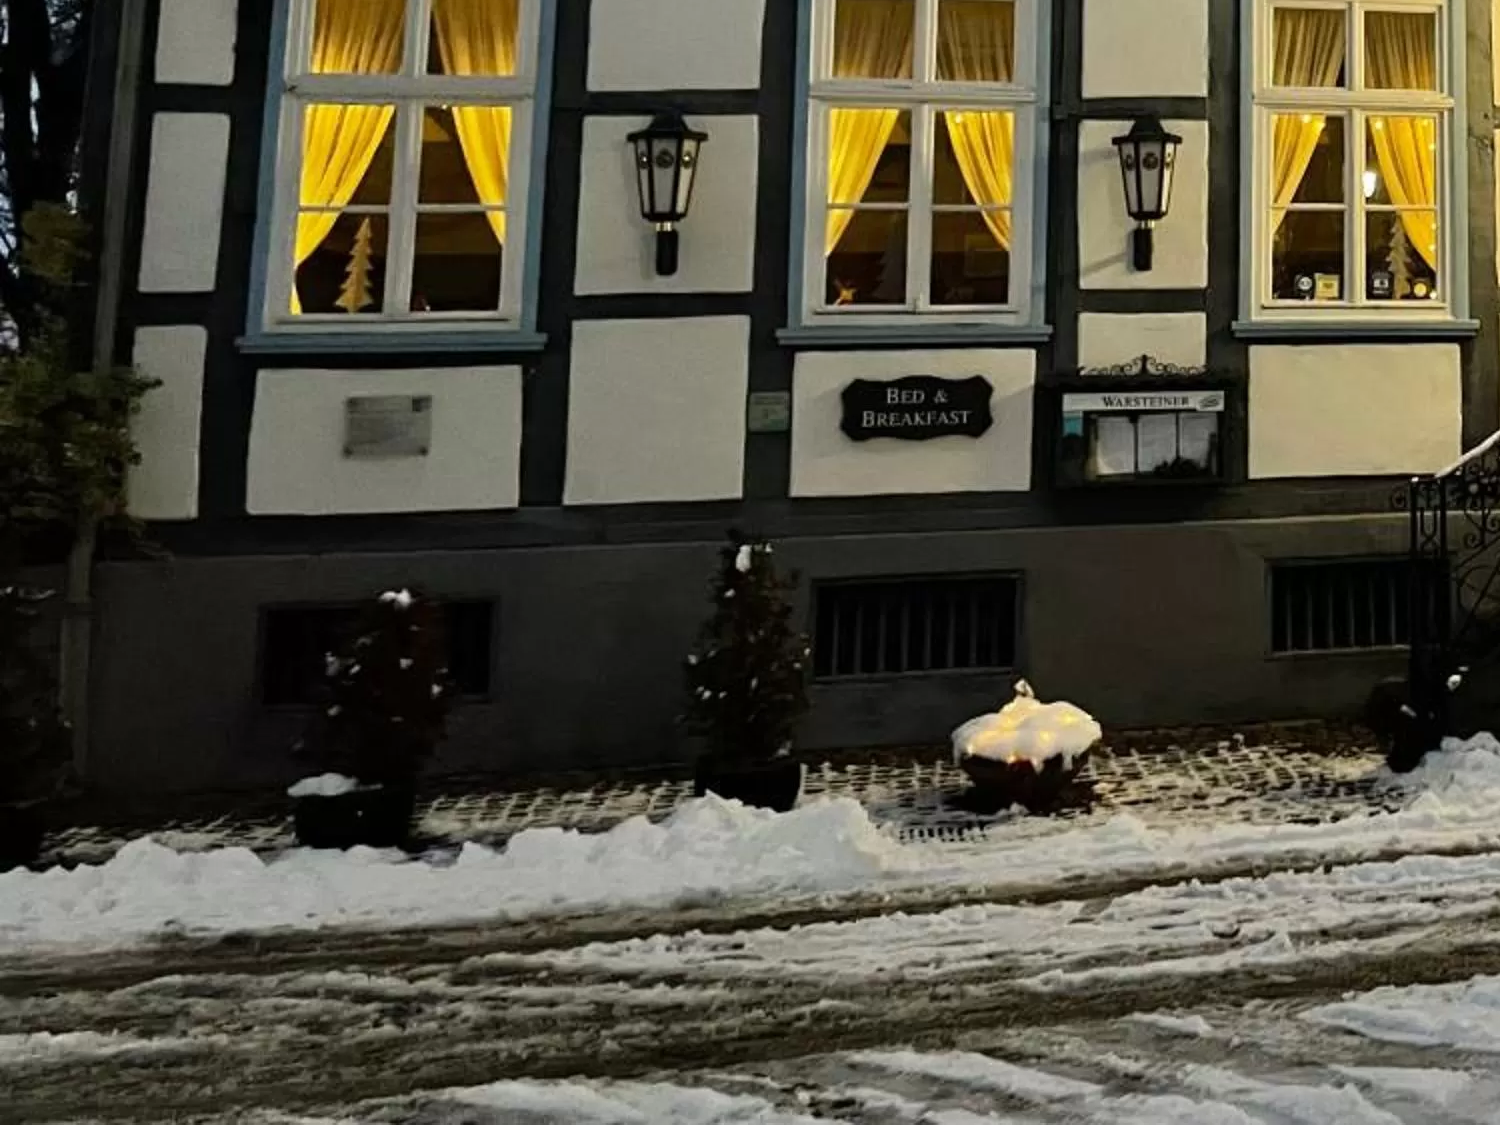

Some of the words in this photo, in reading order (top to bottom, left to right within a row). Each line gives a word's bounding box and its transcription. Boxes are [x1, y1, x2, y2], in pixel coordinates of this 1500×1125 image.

[886, 386, 925, 404] BED
[933, 388, 949, 404] &
[1102, 395, 1190, 408] WARSTEINER
[861, 410, 973, 428] BREAKFAST
